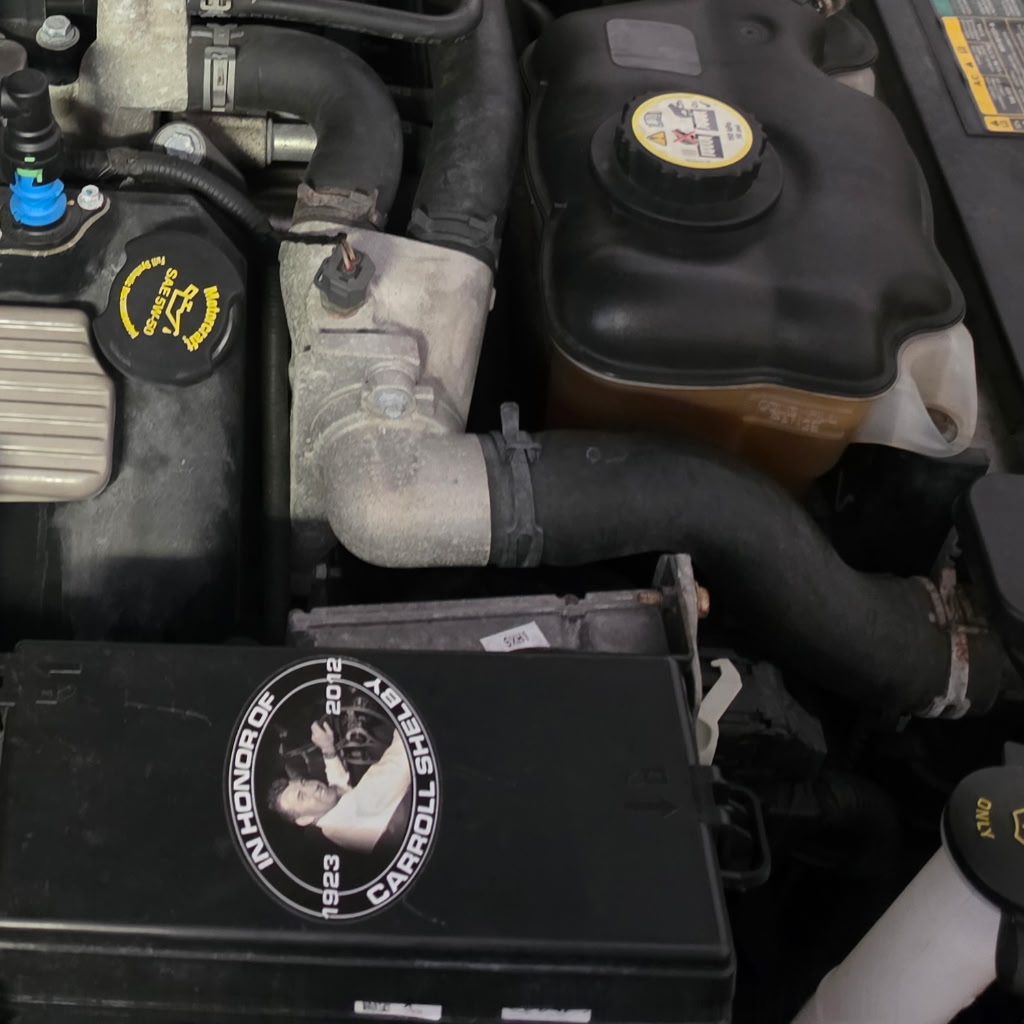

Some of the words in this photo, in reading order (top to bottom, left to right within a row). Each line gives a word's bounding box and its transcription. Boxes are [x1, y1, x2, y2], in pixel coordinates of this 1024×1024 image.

[158, 267, 178, 297] SAE
[143, 296, 166, 336] 5W-50
[248, 691, 276, 729] OF
[326, 657, 342, 716] 2012
[363, 678, 434, 775] SHELBY
[233, 727, 259, 835] HONOR
[975, 797, 995, 839] ONLY
[246, 837, 274, 871] IN
[366, 781, 435, 906] CARROLL
[322, 854, 340, 919] 1923
